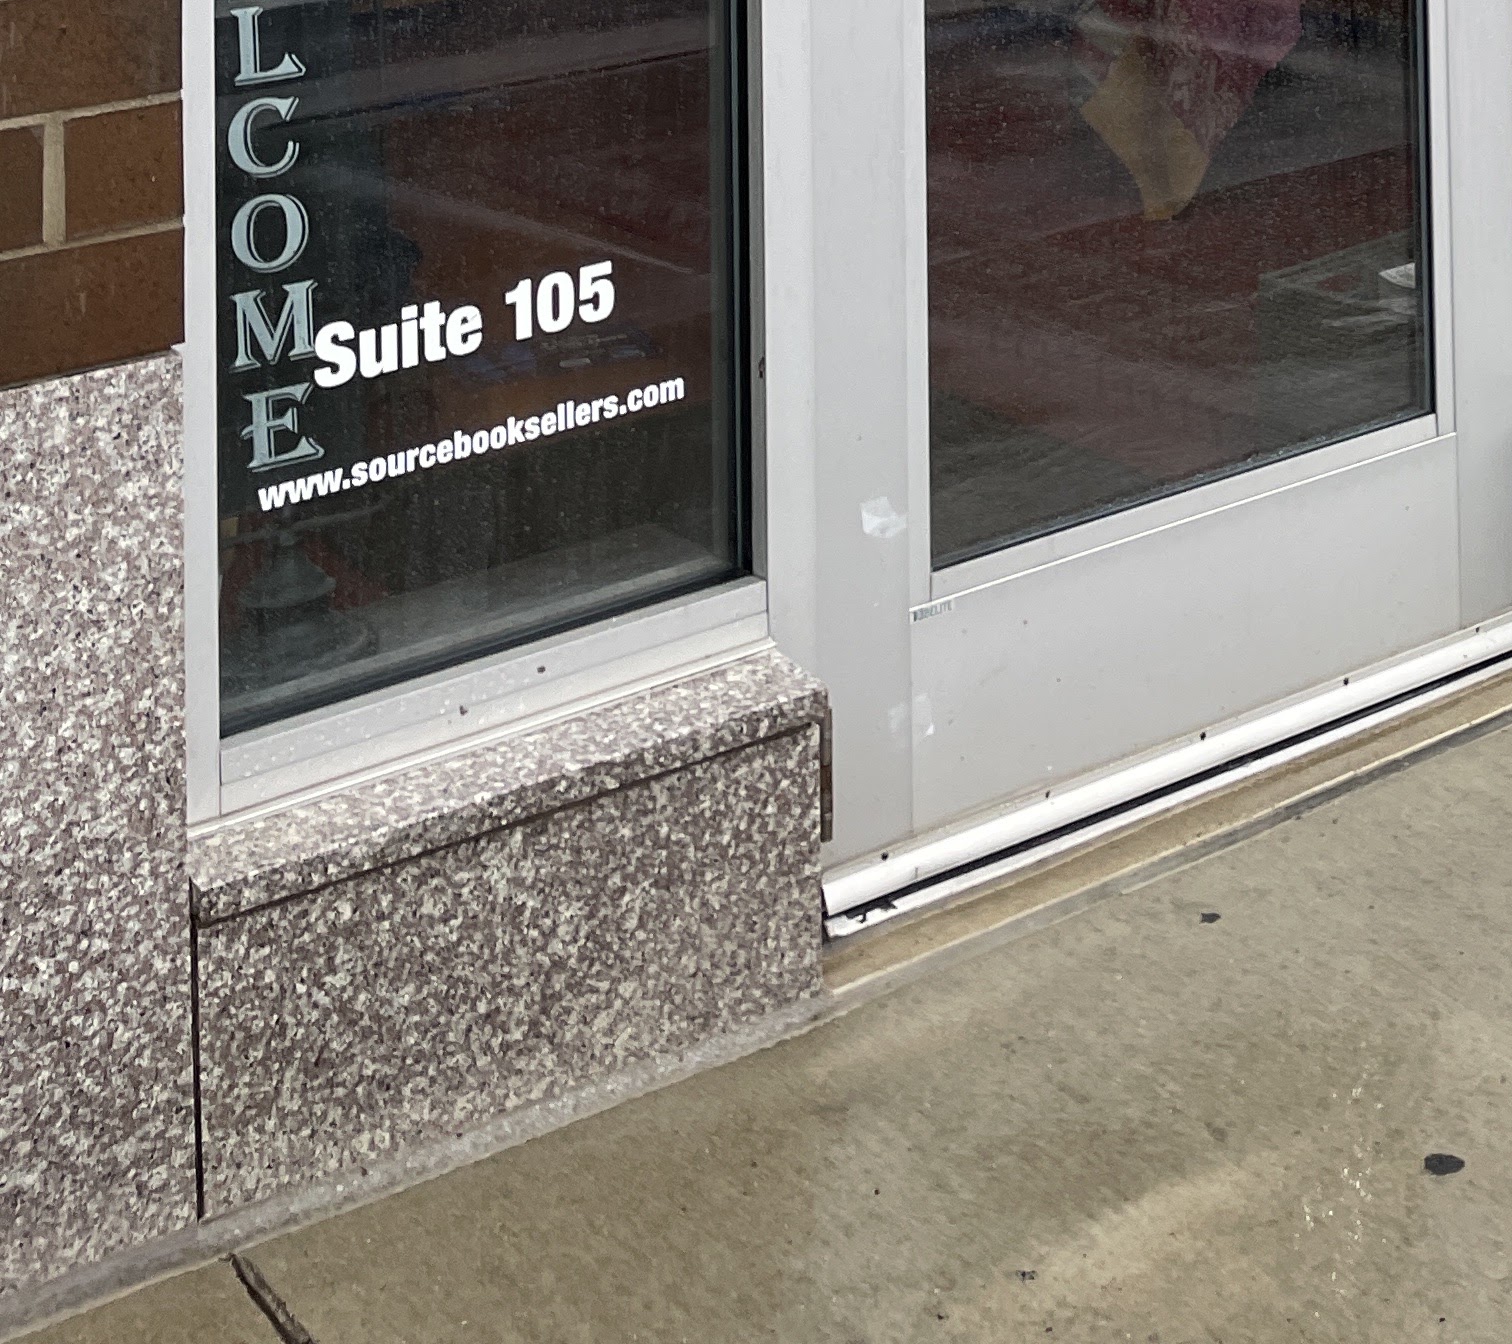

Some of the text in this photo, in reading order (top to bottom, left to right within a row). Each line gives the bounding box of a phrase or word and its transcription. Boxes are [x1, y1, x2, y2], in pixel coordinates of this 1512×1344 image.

[313, 259, 616, 388] Suite 105
[258, 375, 686, 512] www.sourcebooksellers.com
